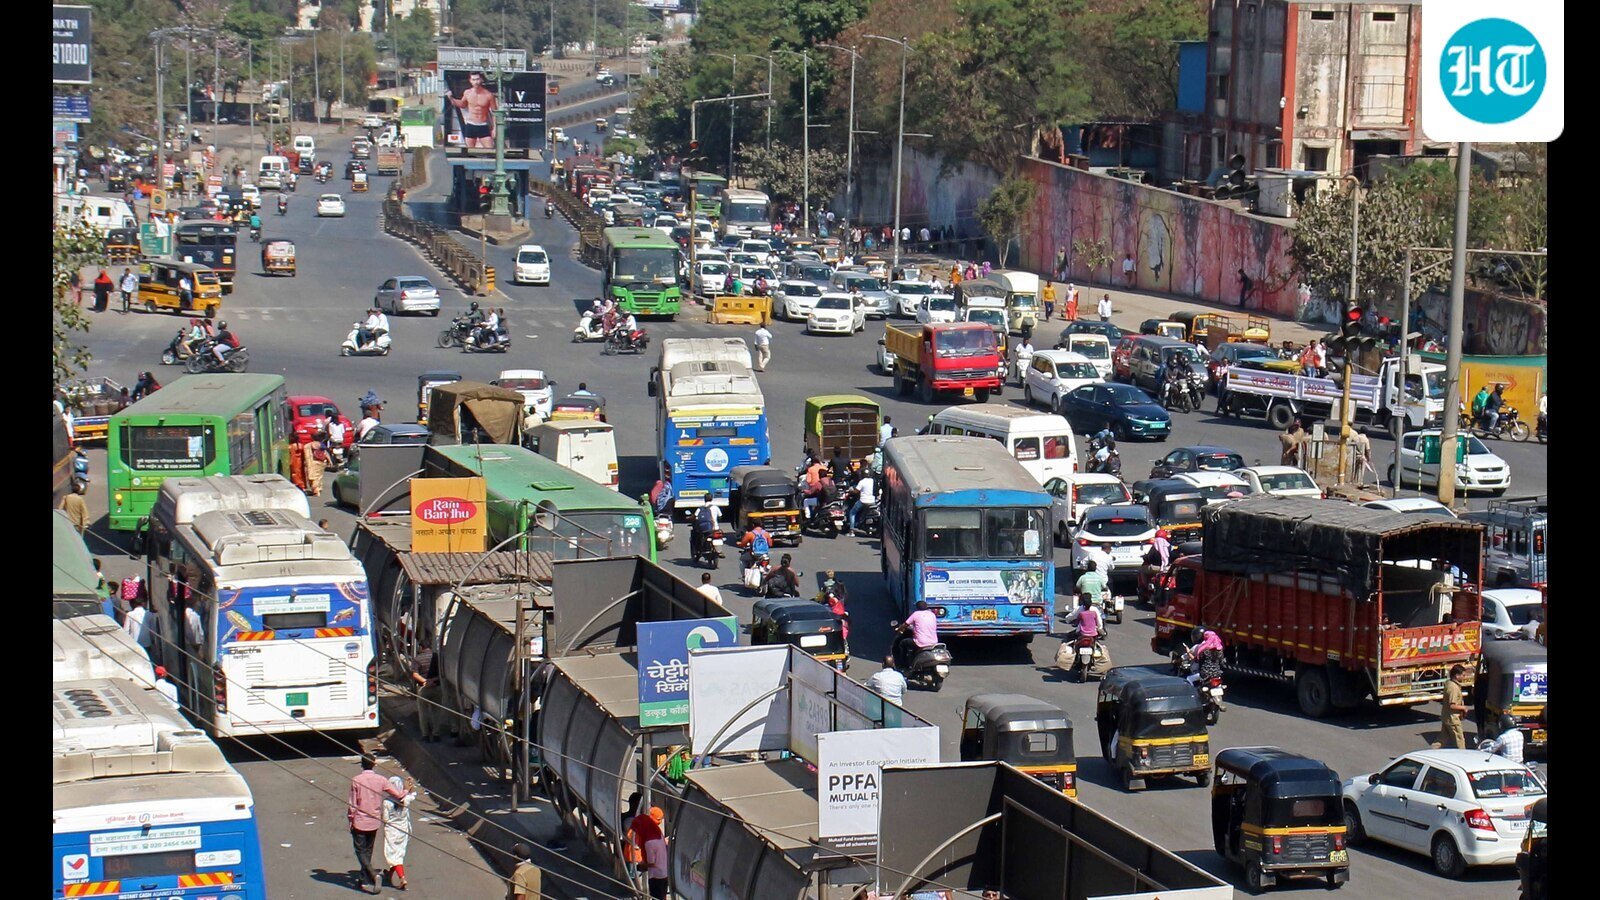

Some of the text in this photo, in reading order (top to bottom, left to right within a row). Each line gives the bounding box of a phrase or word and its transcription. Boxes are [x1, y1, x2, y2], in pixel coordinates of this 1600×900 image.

[433, 500, 460, 510] Ram
[424, 508, 470, 519] Bandhu
[829, 793, 868, 802] MUTUAL
